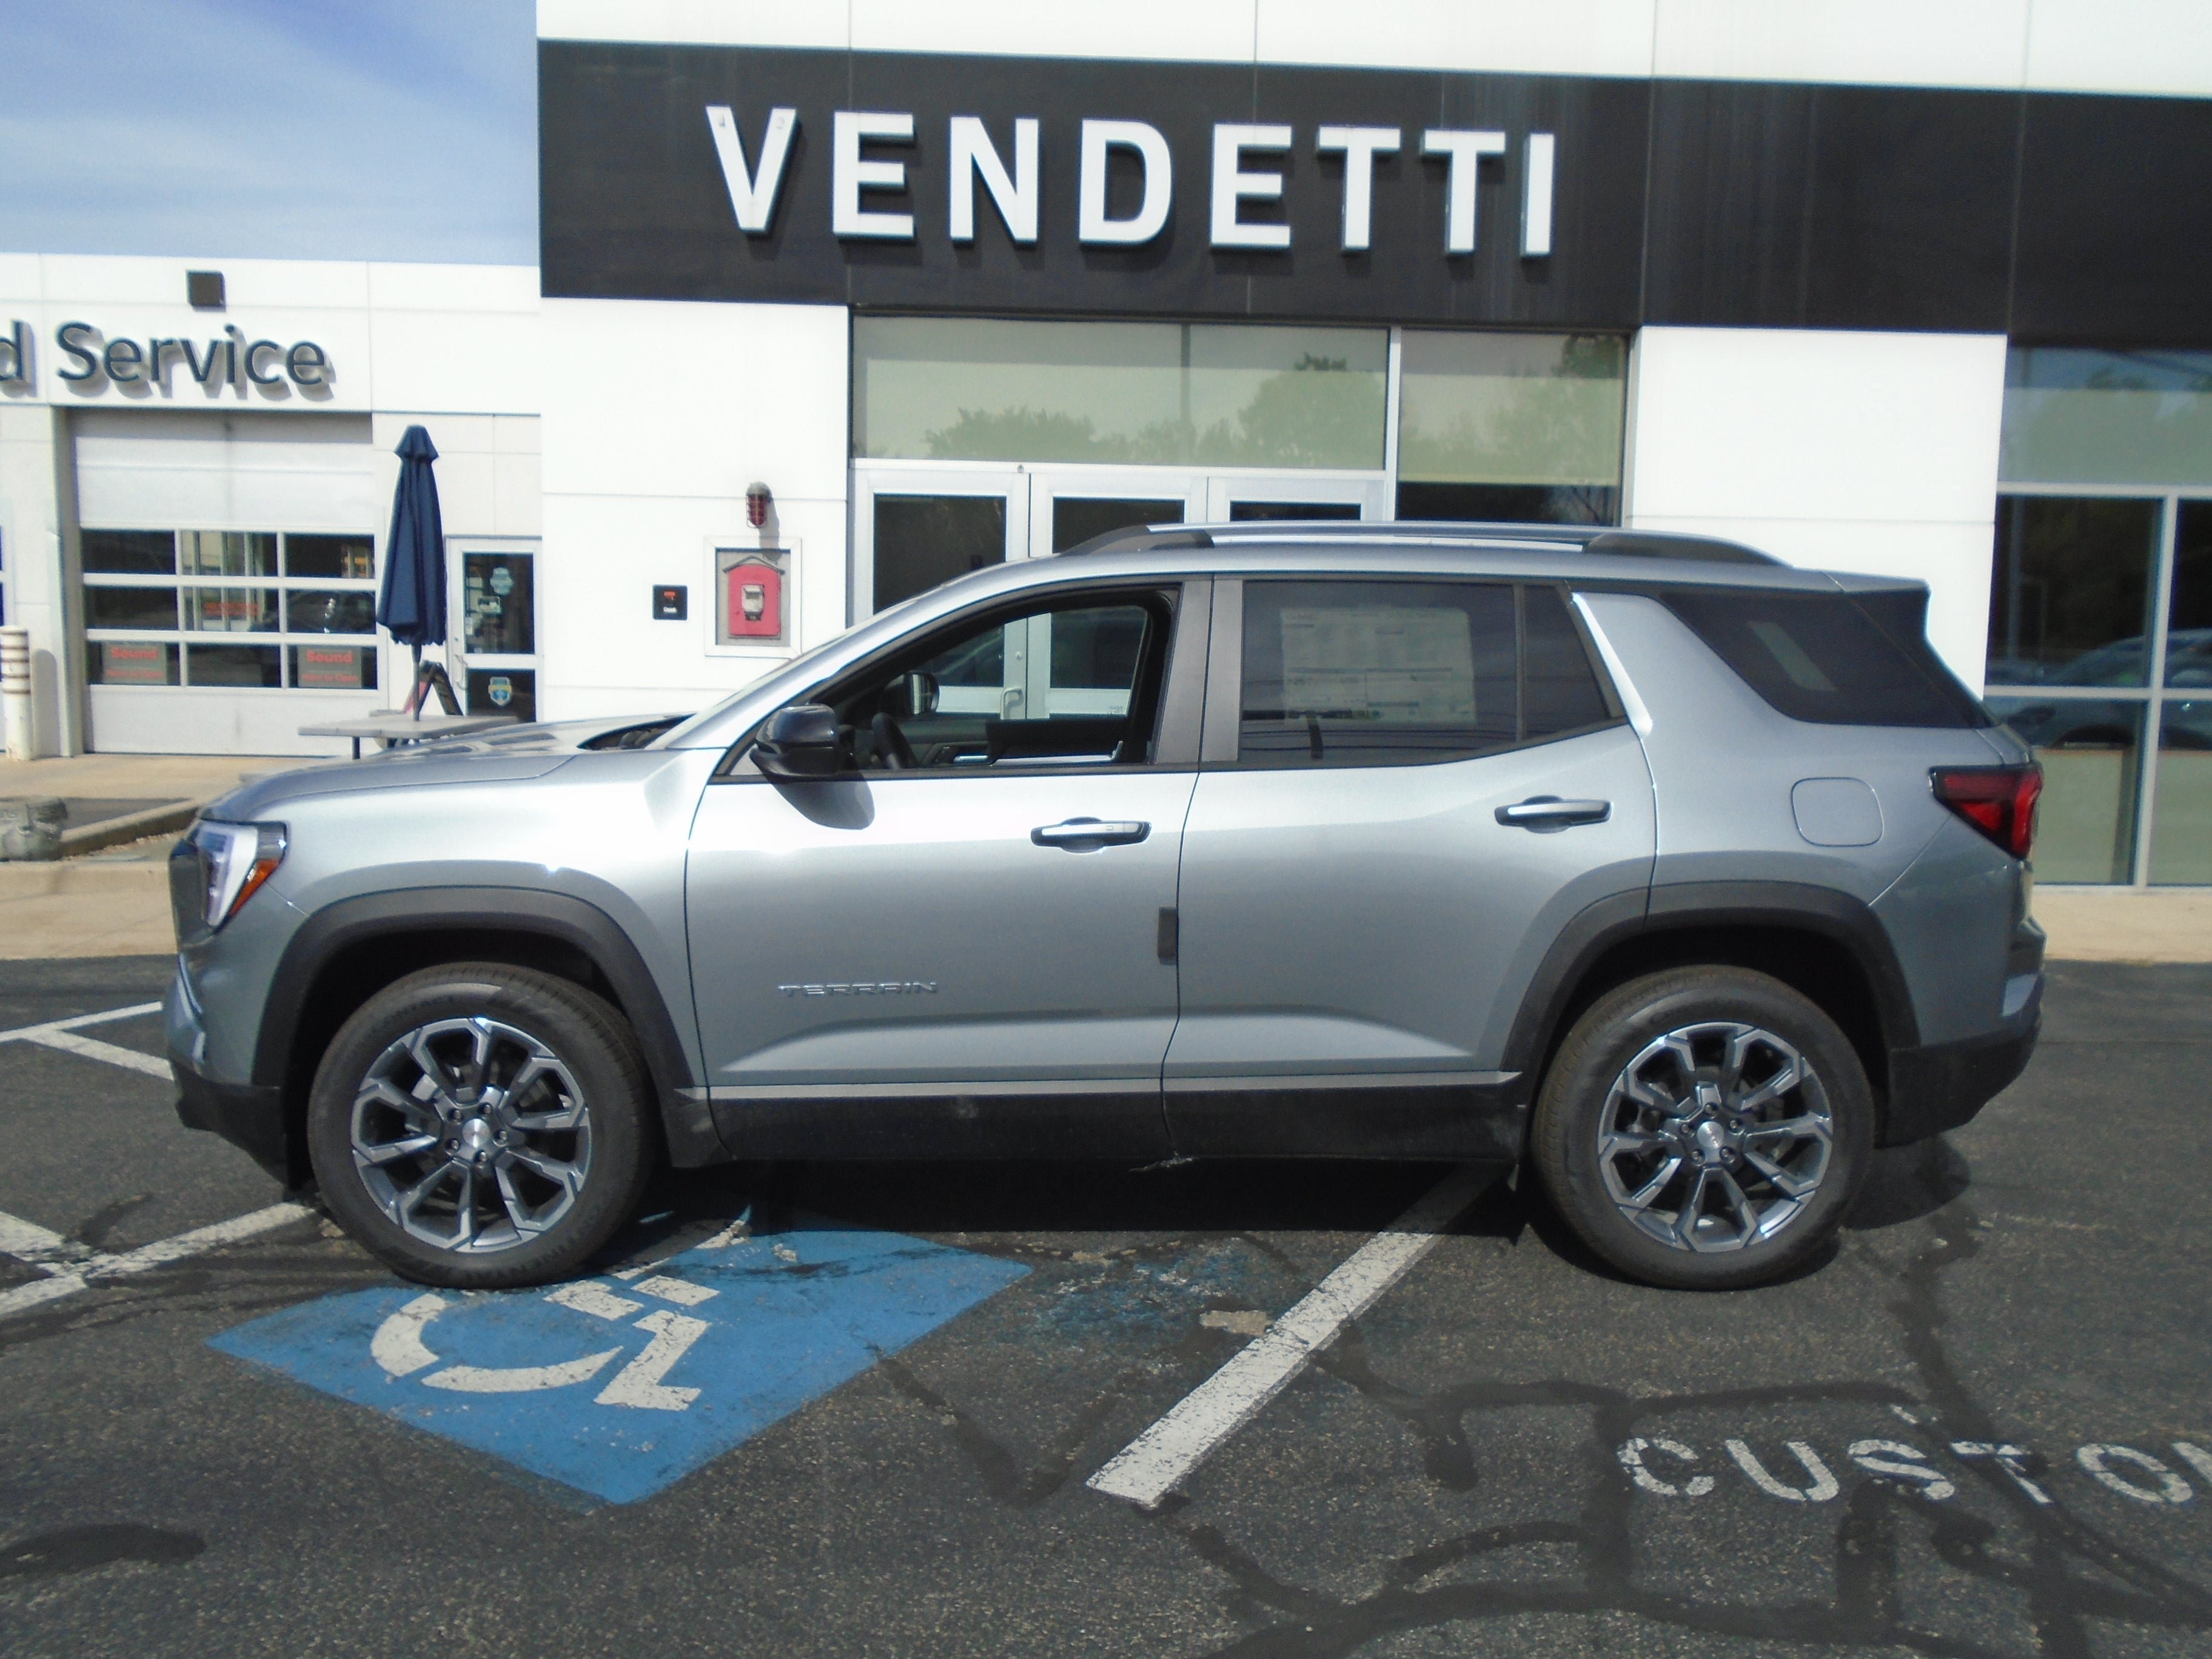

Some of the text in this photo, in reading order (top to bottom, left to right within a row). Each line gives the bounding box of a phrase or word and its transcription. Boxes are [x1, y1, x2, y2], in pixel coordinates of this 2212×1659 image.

[705, 106, 1555, 256] VENDETTI
[56, 322, 326, 386] Service
[306, 650, 354, 664] Sound
[778, 981, 937, 996] TERRAIN
